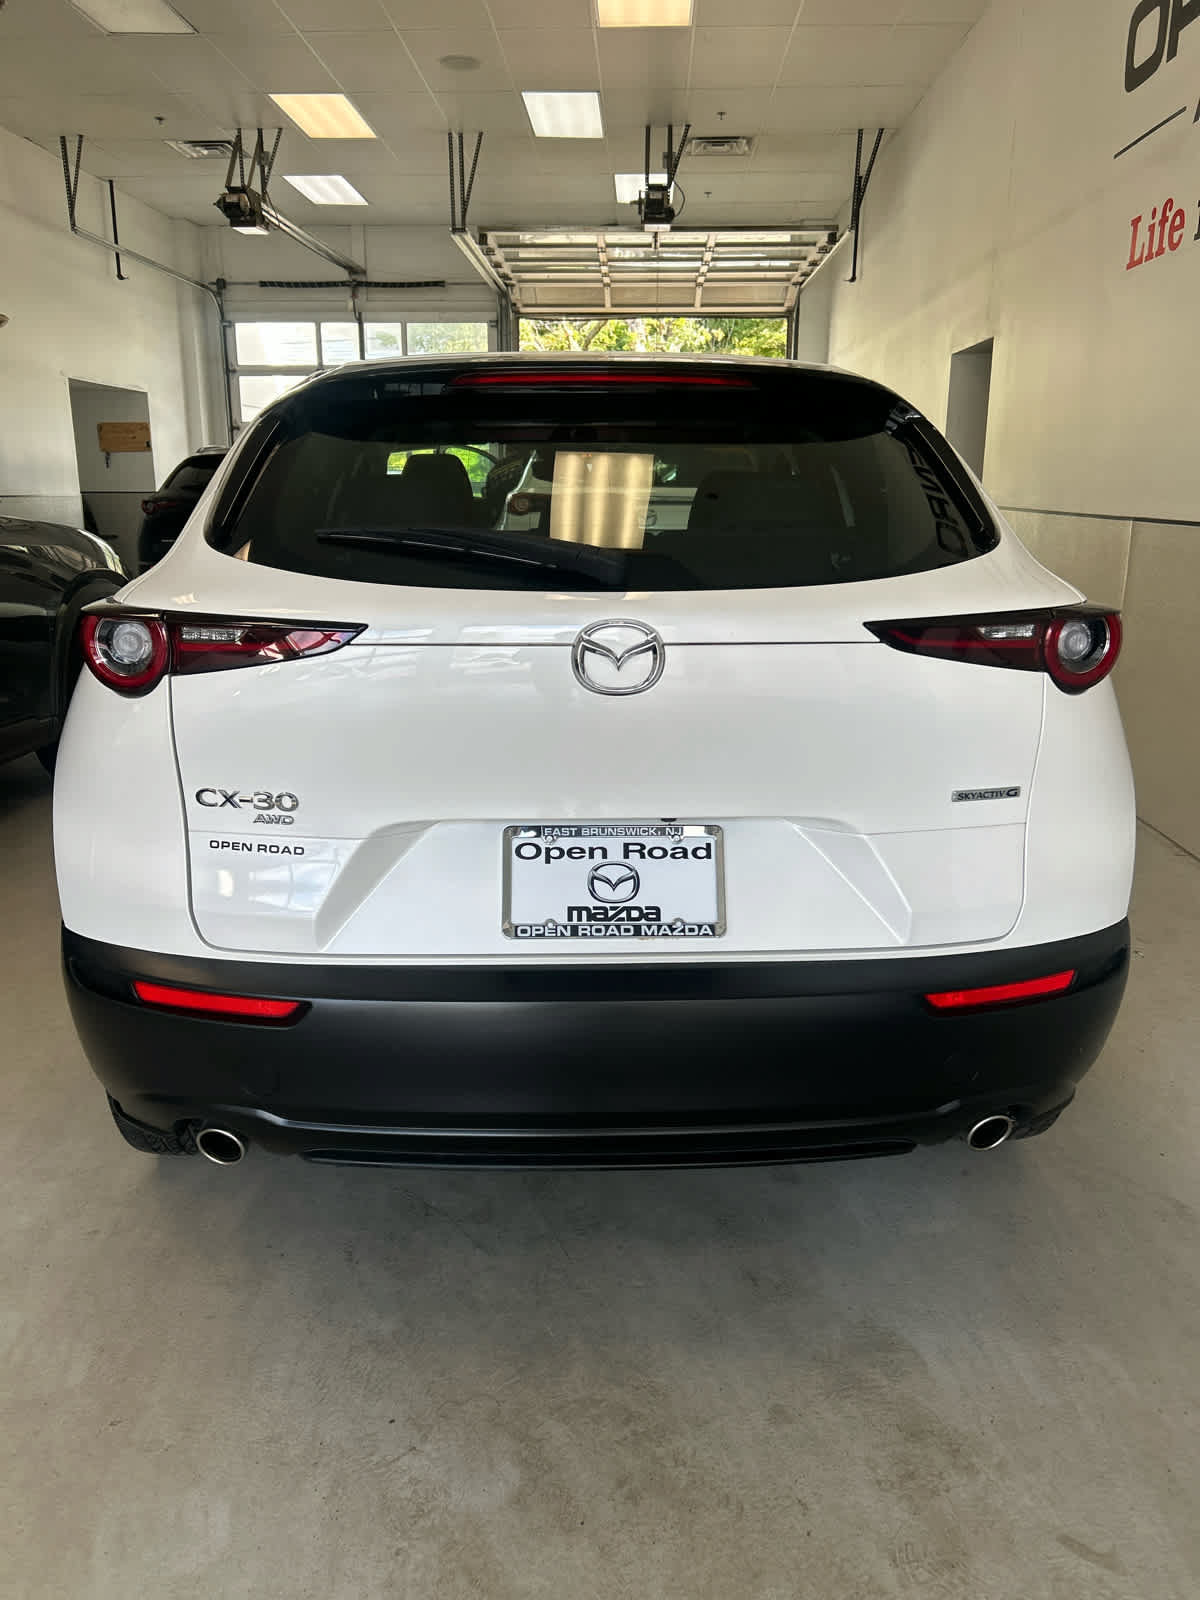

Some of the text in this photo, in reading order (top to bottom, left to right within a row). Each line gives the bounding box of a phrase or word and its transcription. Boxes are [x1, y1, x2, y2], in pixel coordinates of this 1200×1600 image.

[1126, 198, 1185, 271] Life
[195, 787, 300, 812] CX-30
[253, 813, 295, 825] AWD
[544, 827, 578, 837] EAST
[666, 827, 684, 837] NJ
[209, 839, 305, 856] OPEN ROAD
[514, 842, 713, 864] Open Road
[516, 924, 713, 937] OPEN ROAD MAZDA
